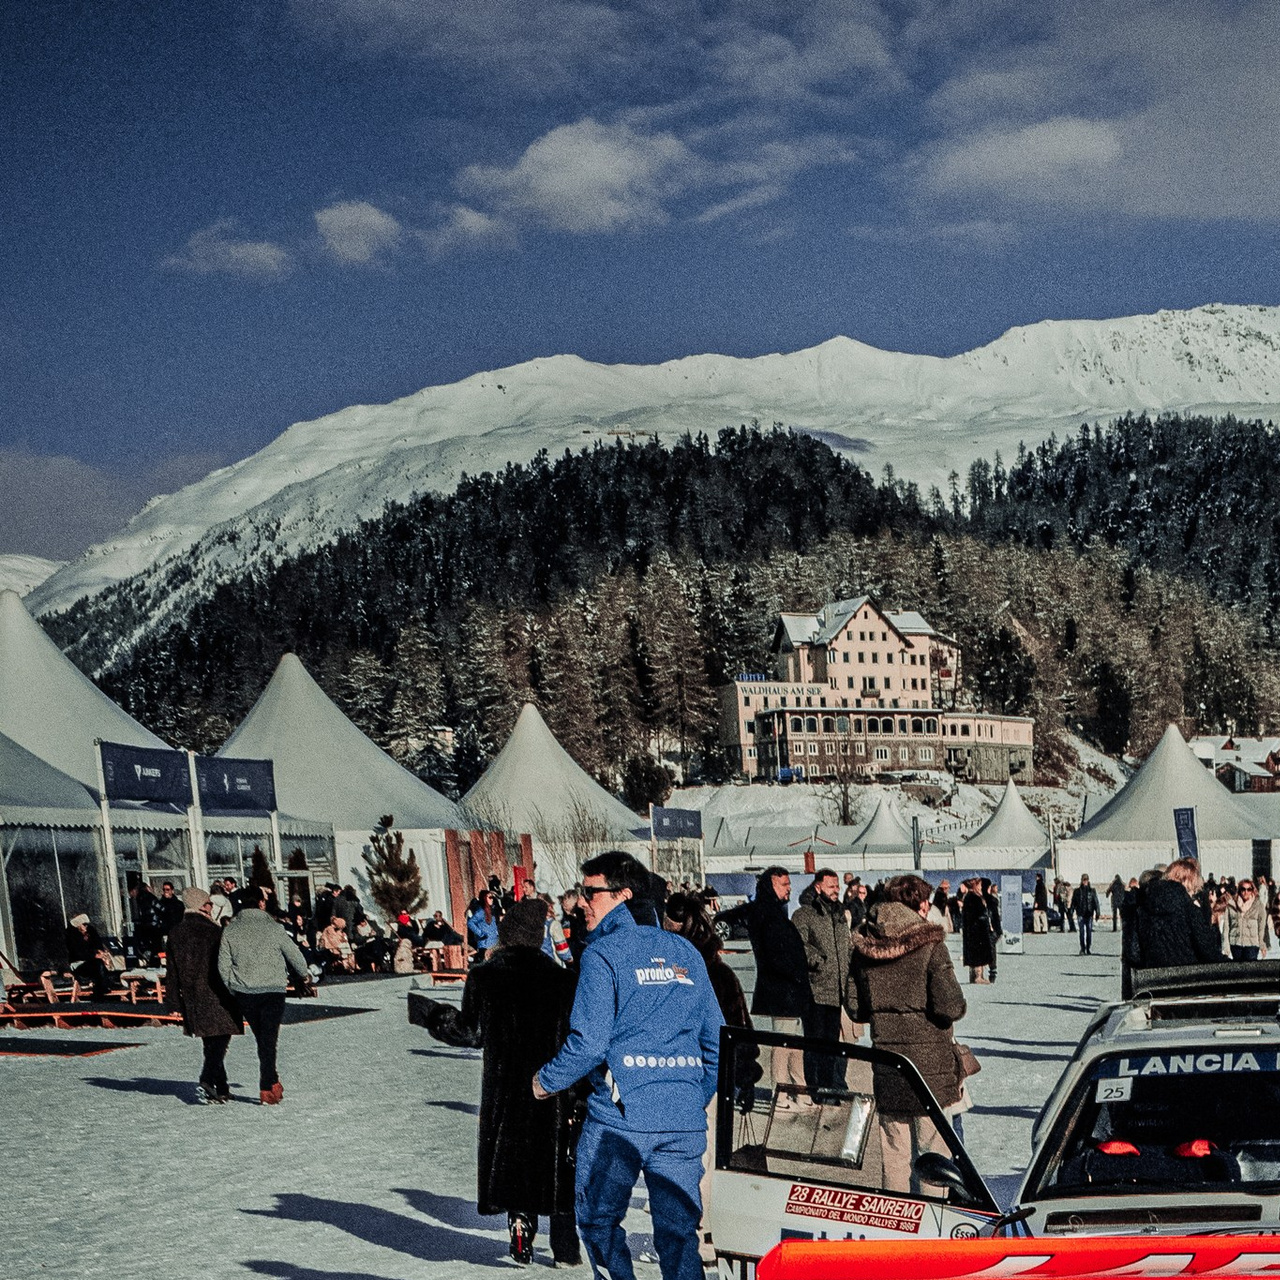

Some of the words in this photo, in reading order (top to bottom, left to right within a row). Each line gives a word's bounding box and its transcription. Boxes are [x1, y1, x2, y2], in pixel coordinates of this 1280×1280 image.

[740, 686, 788, 695] WALDHAUS
[791, 687, 804, 695] AM
[806, 687, 822, 695] SEE
[1118, 1052, 1261, 1077] LANCIA
[1103, 1087, 1125, 1100] 25
[790, 1186, 808, 1201] 28
[811, 1189, 859, 1209] RALLYE
[860, 1196, 925, 1220] SANREMO
[786, 1203, 828, 1218] CAMPIONATO
[828, 1210, 841, 1220] DEL
[843, 1212, 868, 1224] MONDO
[869, 1217, 898, 1229] RALLYES
